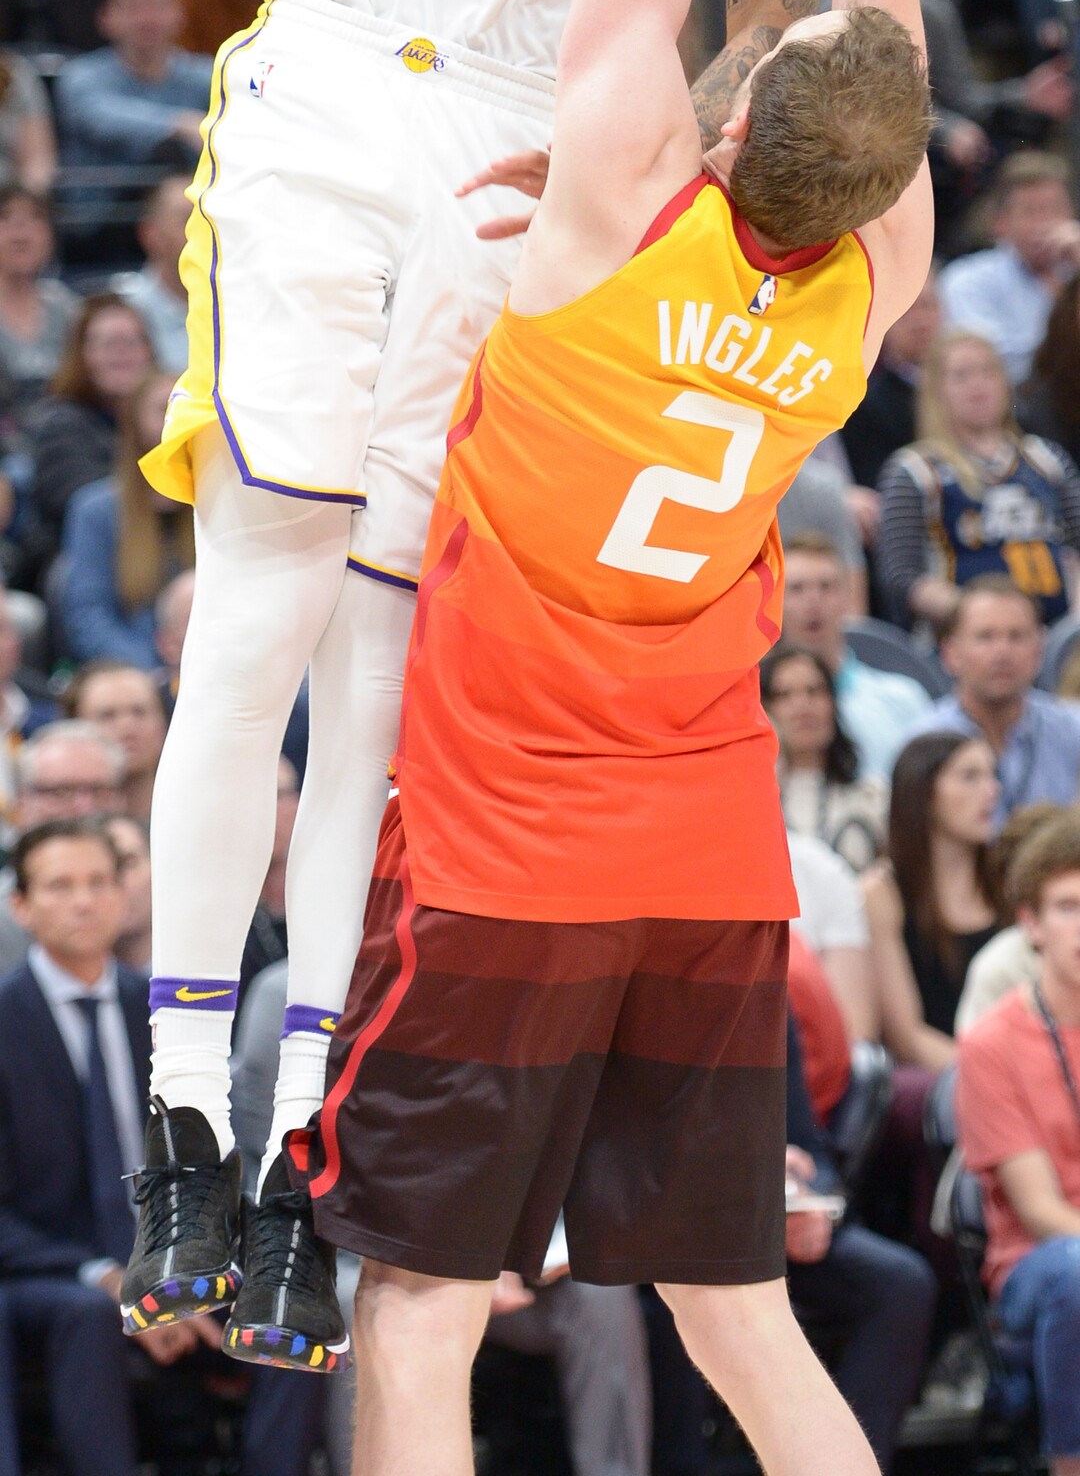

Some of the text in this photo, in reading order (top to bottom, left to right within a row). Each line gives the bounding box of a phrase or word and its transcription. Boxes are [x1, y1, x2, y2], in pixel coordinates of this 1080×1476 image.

[395, 41, 446, 73] LAKERS
[657, 300, 833, 407] INGLES
[596, 390, 765, 583] 2
